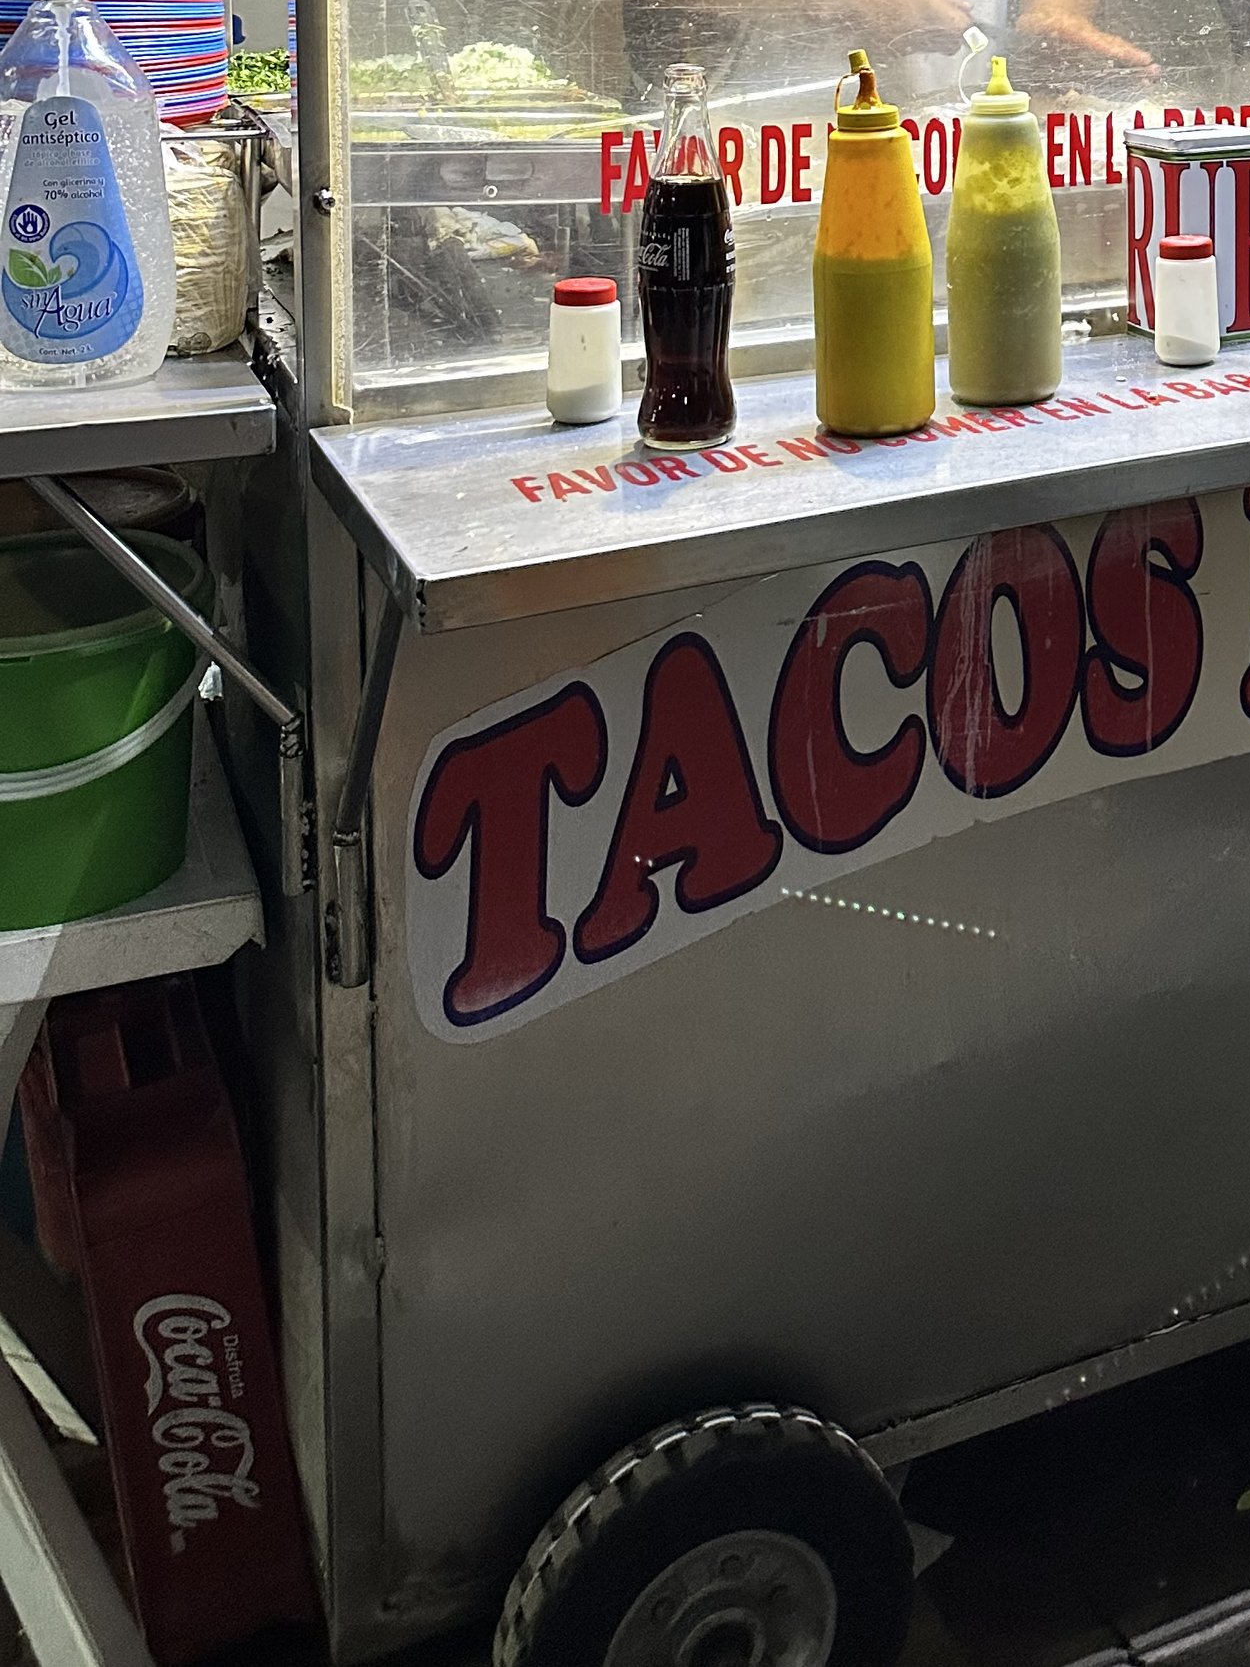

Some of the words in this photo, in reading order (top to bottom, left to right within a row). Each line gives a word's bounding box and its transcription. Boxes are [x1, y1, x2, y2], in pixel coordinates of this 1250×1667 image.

[22, 130, 100, 147] antiséptico
[44, 111, 76, 129] Gel
[760, 123, 812, 205] DE
[1048, 113, 1092, 189] EN
[44, 189, 68, 200] 70%
[71, 189, 103, 199] alcohol
[511, 456, 700, 503] FAVOR
[700, 444, 783, 474] DE
[777, 434, 862, 462] NO
[1041, 396, 1112, 422] EN
[1097, 386, 1181, 411] LA
[414, 494, 1204, 1027] TACOS
[222, 1333, 246, 1400] Disfruta
